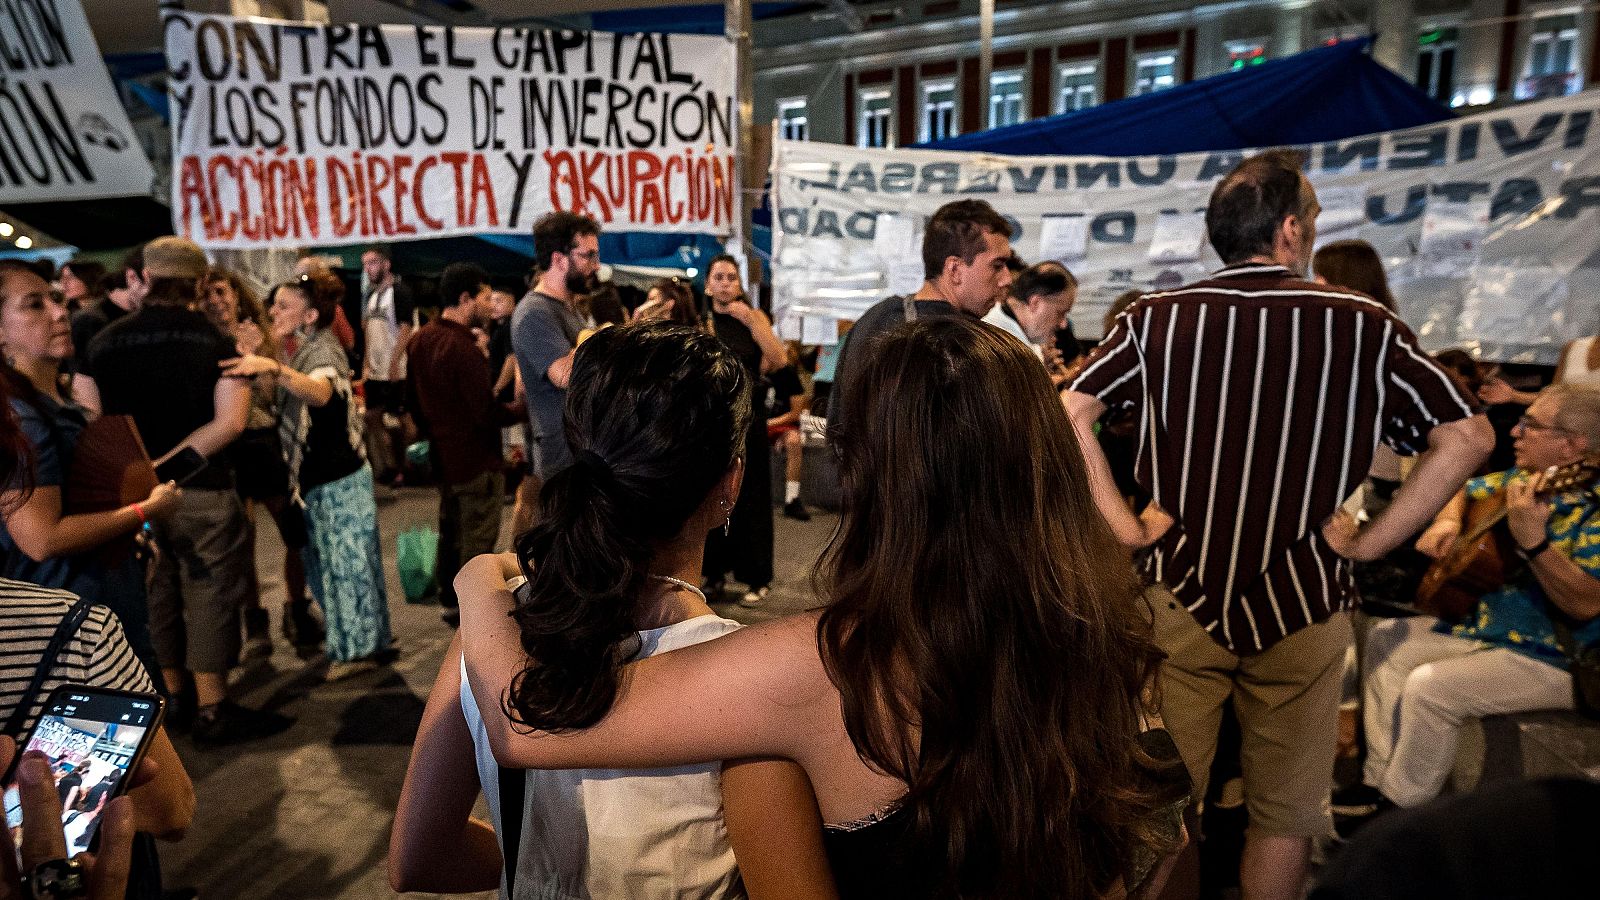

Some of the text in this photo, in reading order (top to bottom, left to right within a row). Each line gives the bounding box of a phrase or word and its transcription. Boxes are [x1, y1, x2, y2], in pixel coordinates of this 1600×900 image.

[165, 14, 693, 83] CONTRA EL CAPITAL
[168, 72, 733, 155] Y LOS FONDOS DE INVERSIÓN
[505, 151, 534, 228] Y
